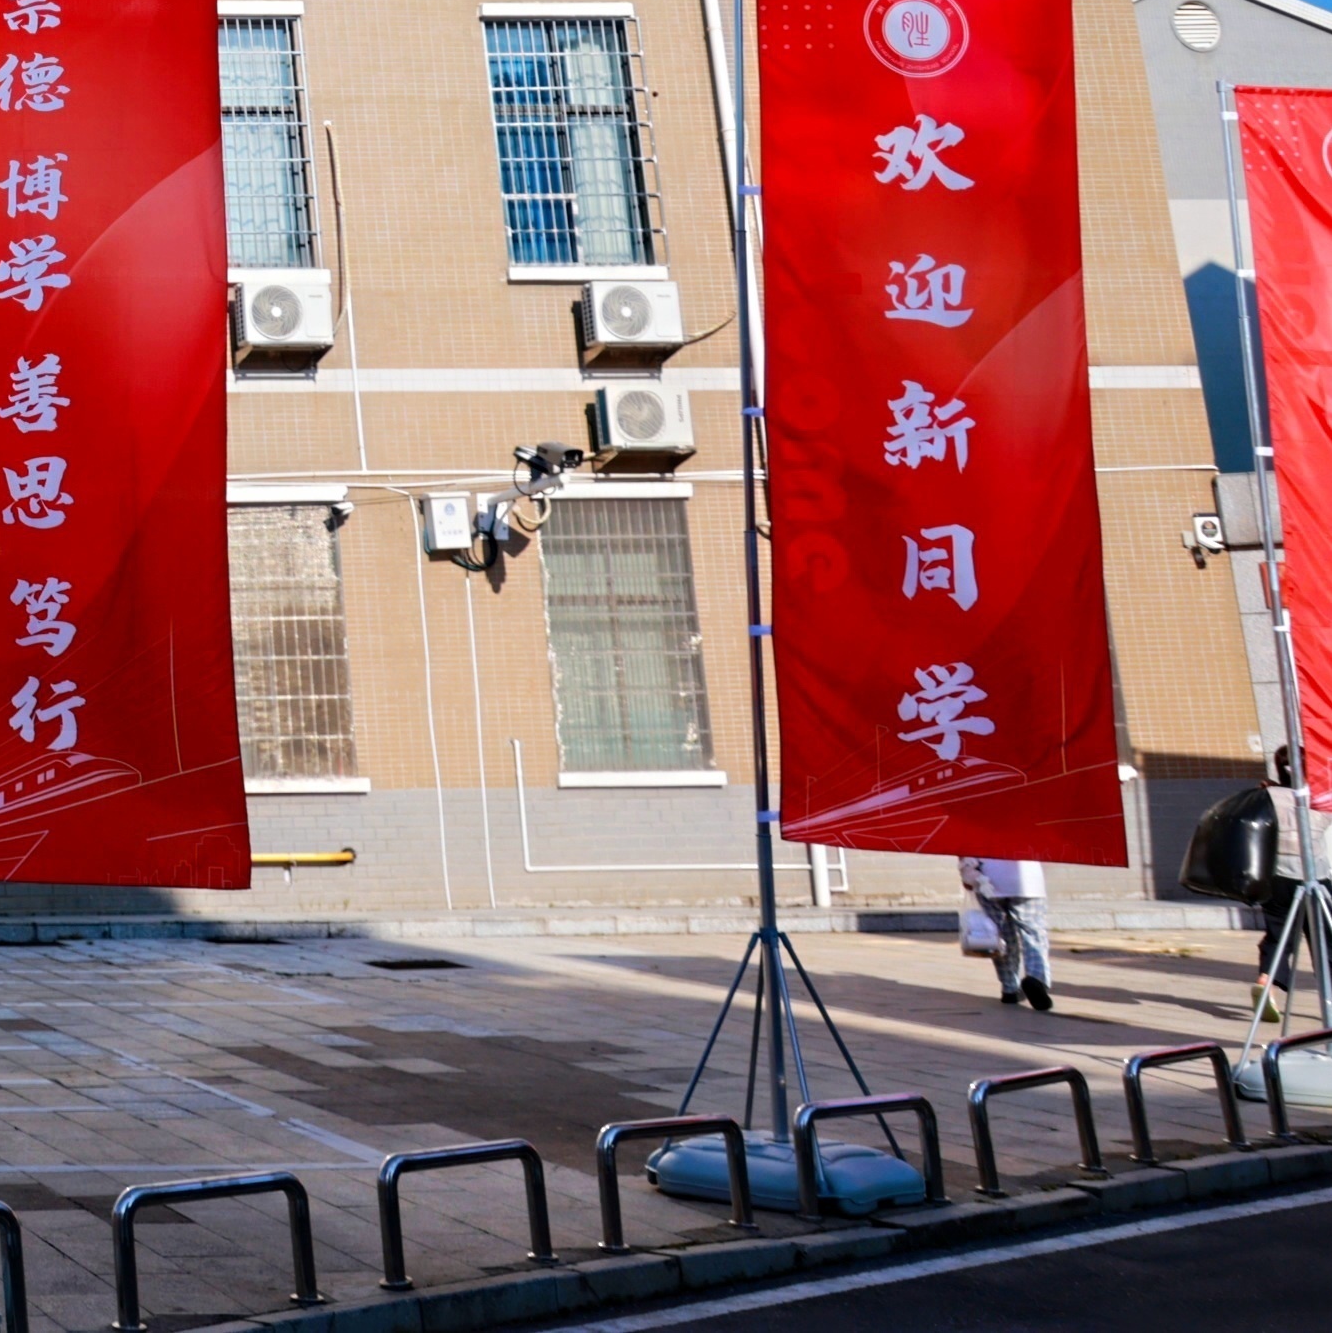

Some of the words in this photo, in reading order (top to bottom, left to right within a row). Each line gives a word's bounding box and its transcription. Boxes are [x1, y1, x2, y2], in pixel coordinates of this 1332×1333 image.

[871, 113, 996, 762] 欢迎新同学
